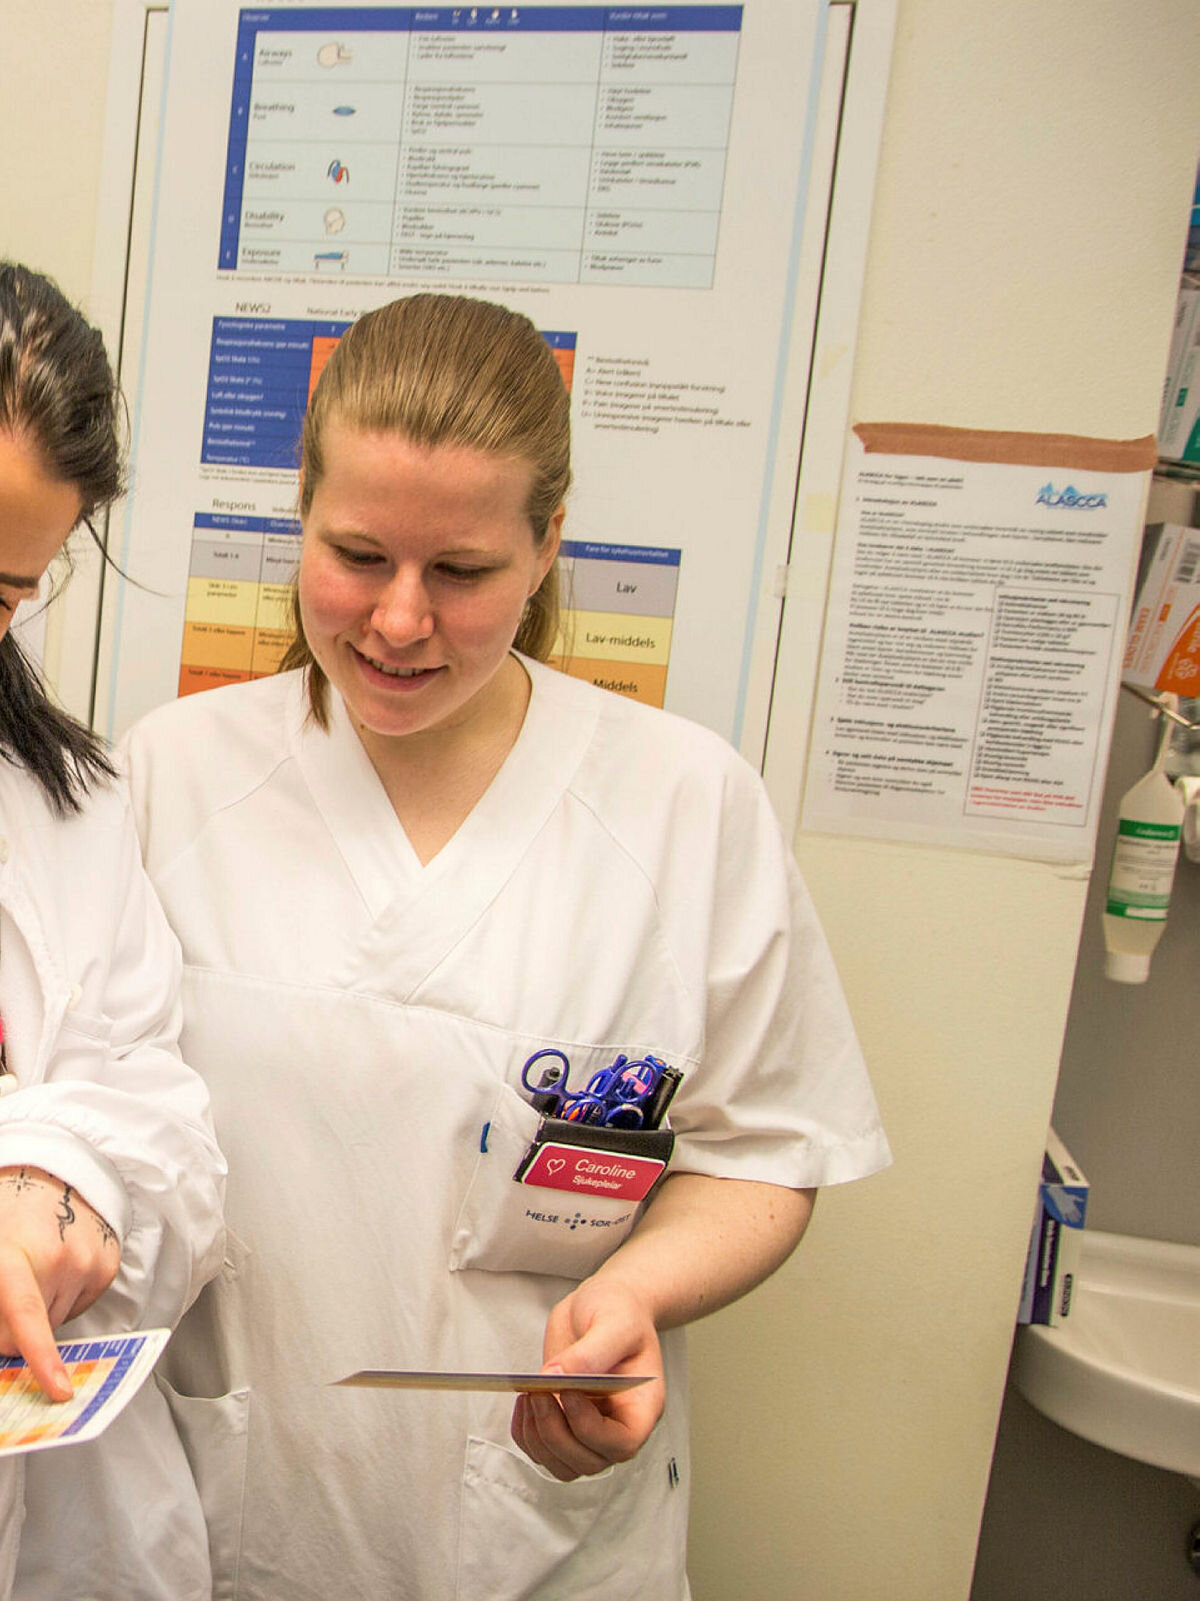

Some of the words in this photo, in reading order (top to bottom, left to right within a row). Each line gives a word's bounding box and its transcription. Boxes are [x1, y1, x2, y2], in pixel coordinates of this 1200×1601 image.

[259, 49, 292, 59] Airways
[253, 102, 296, 114] Breathing
[249, 161, 296, 172] Circulation
[244, 210, 285, 223] Disability
[242, 247, 282, 259] Exposure
[235, 302, 272, 314] NEWS2
[212, 498, 257, 512] Respons
[1034, 493, 1109, 510] ALASCCA
[616, 580, 638, 594] Lav
[586, 632, 656, 649] Lav-middels
[592, 677, 639, 694] Middels
[575, 1158, 637, 1180] Caroline
[524, 1209, 560, 1225] HELSE
